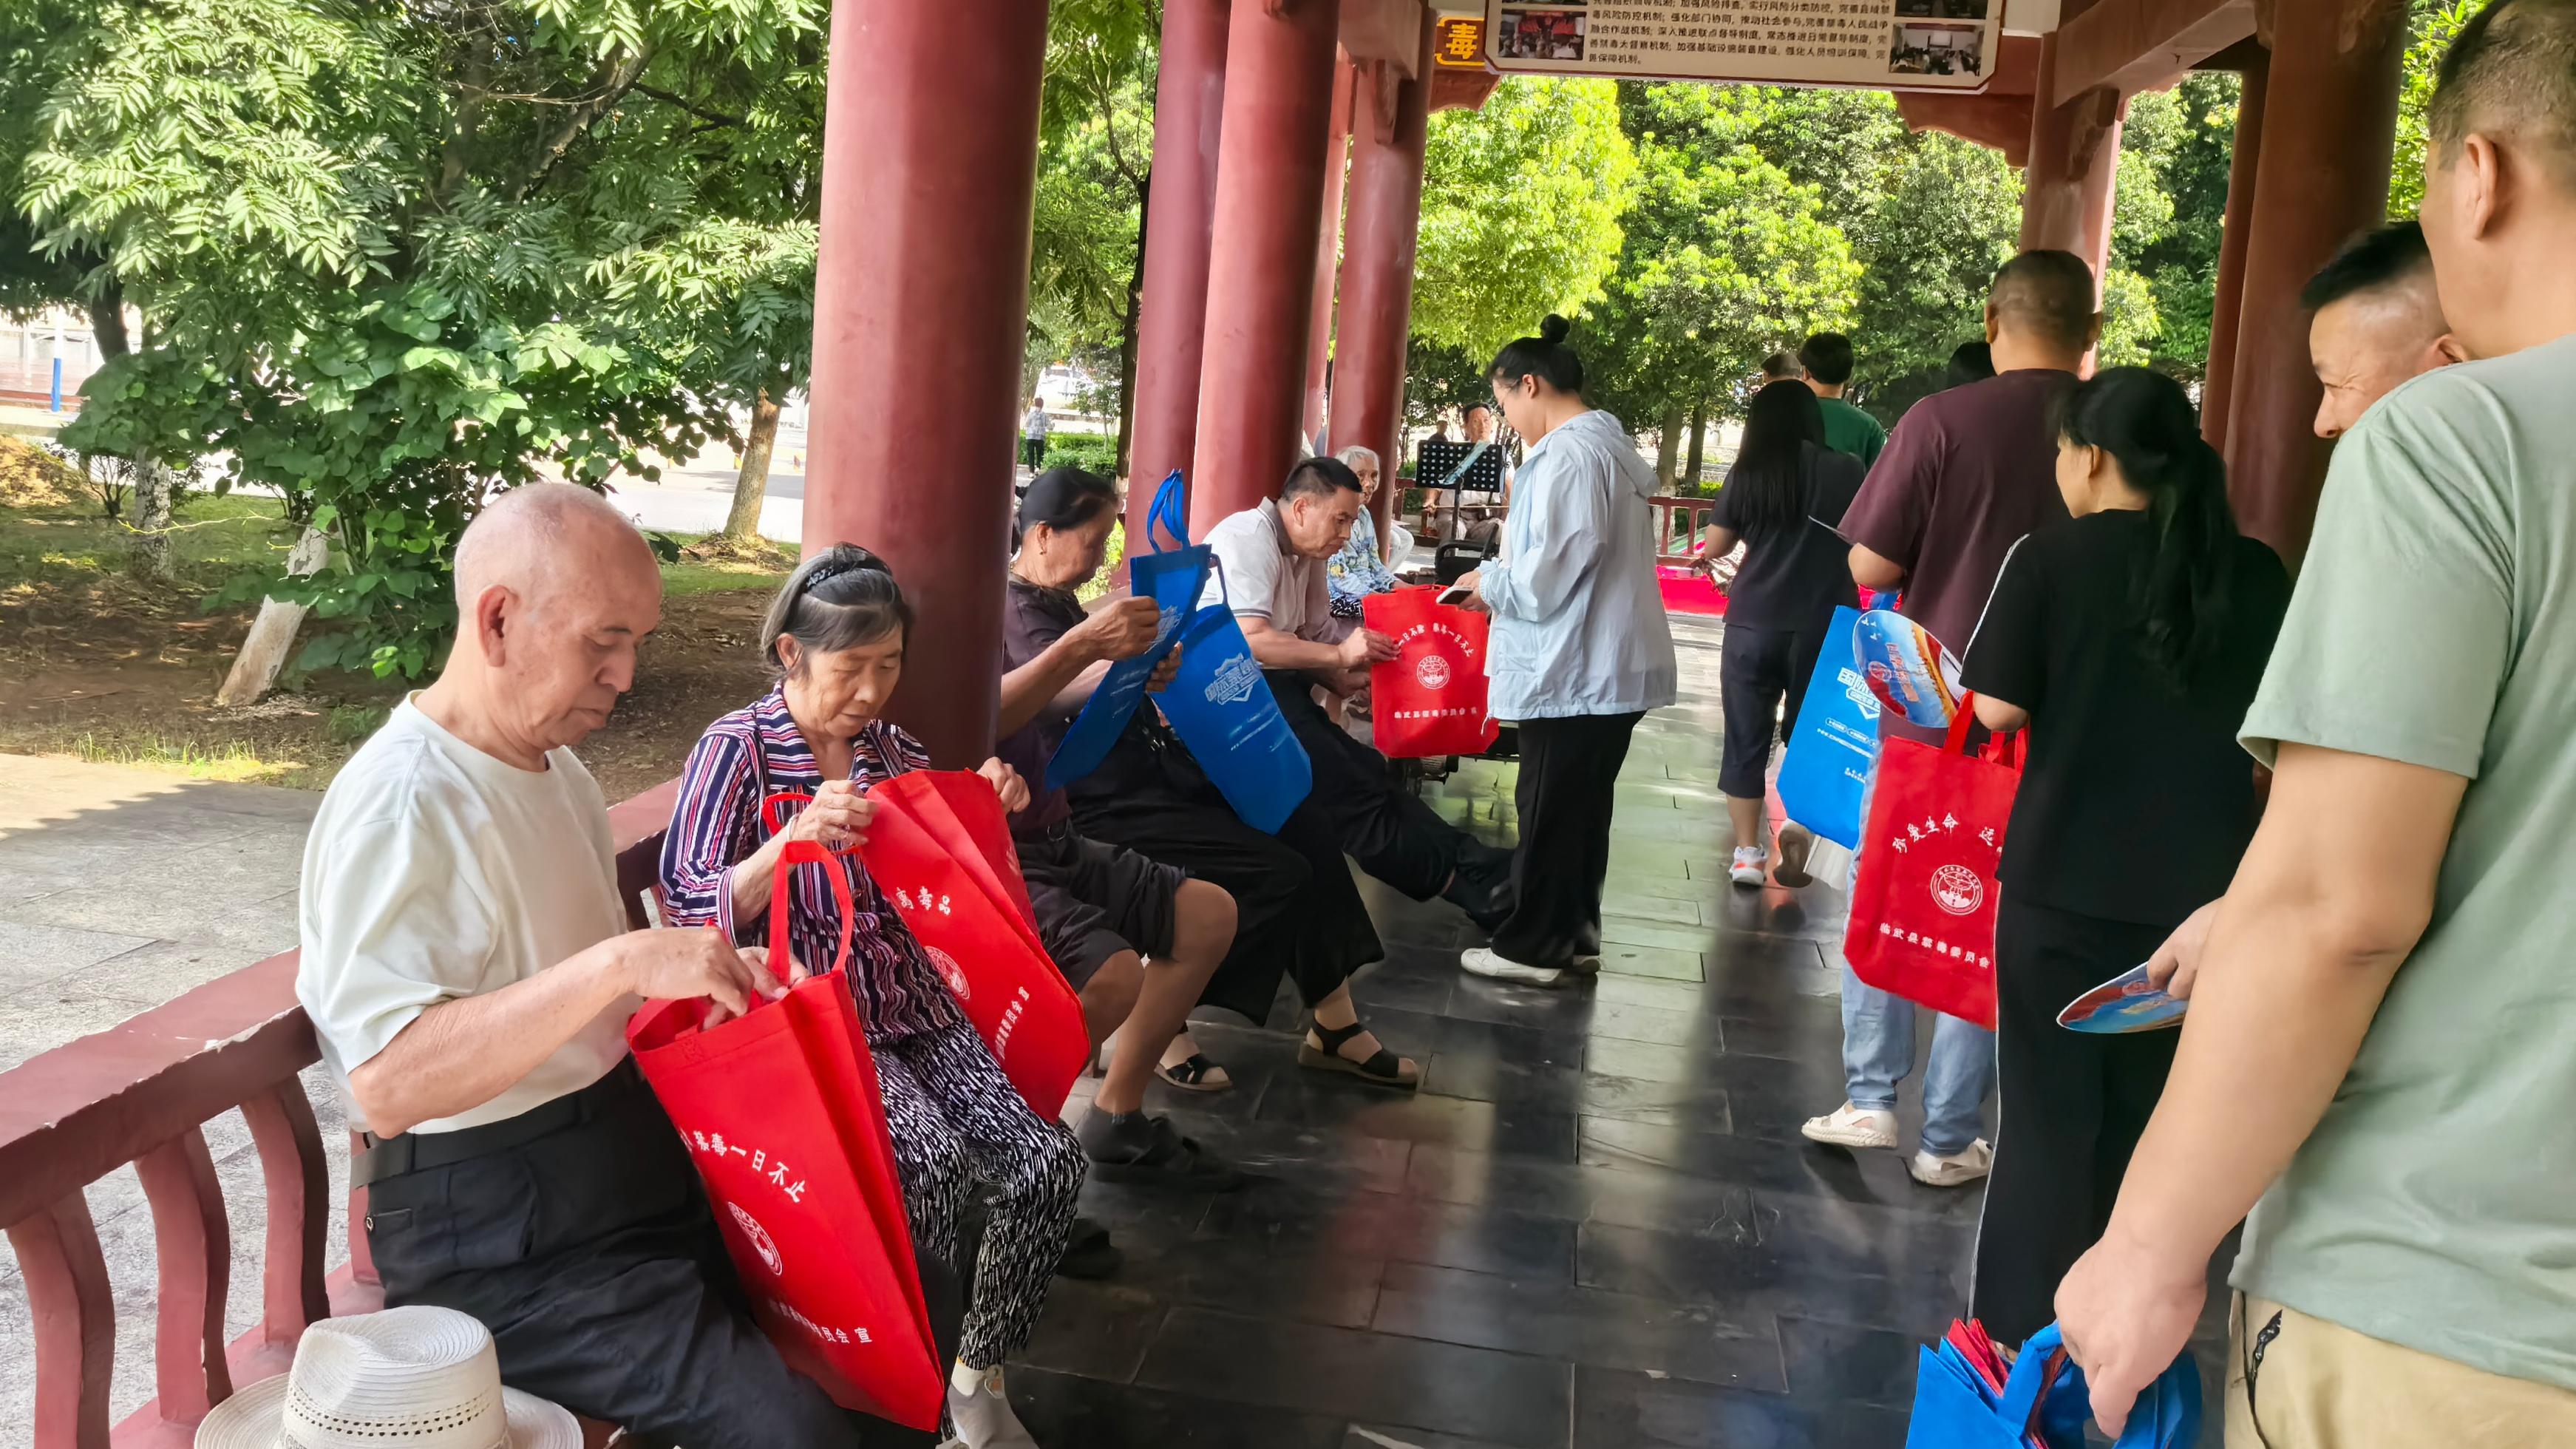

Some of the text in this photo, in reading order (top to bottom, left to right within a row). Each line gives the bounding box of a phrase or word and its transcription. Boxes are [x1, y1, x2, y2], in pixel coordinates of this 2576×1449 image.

[1446, 23, 1478, 59] 毒
[1892, 812, 1960, 854] 珍爱生命
[854, 1326, 873, 1344] 宣
